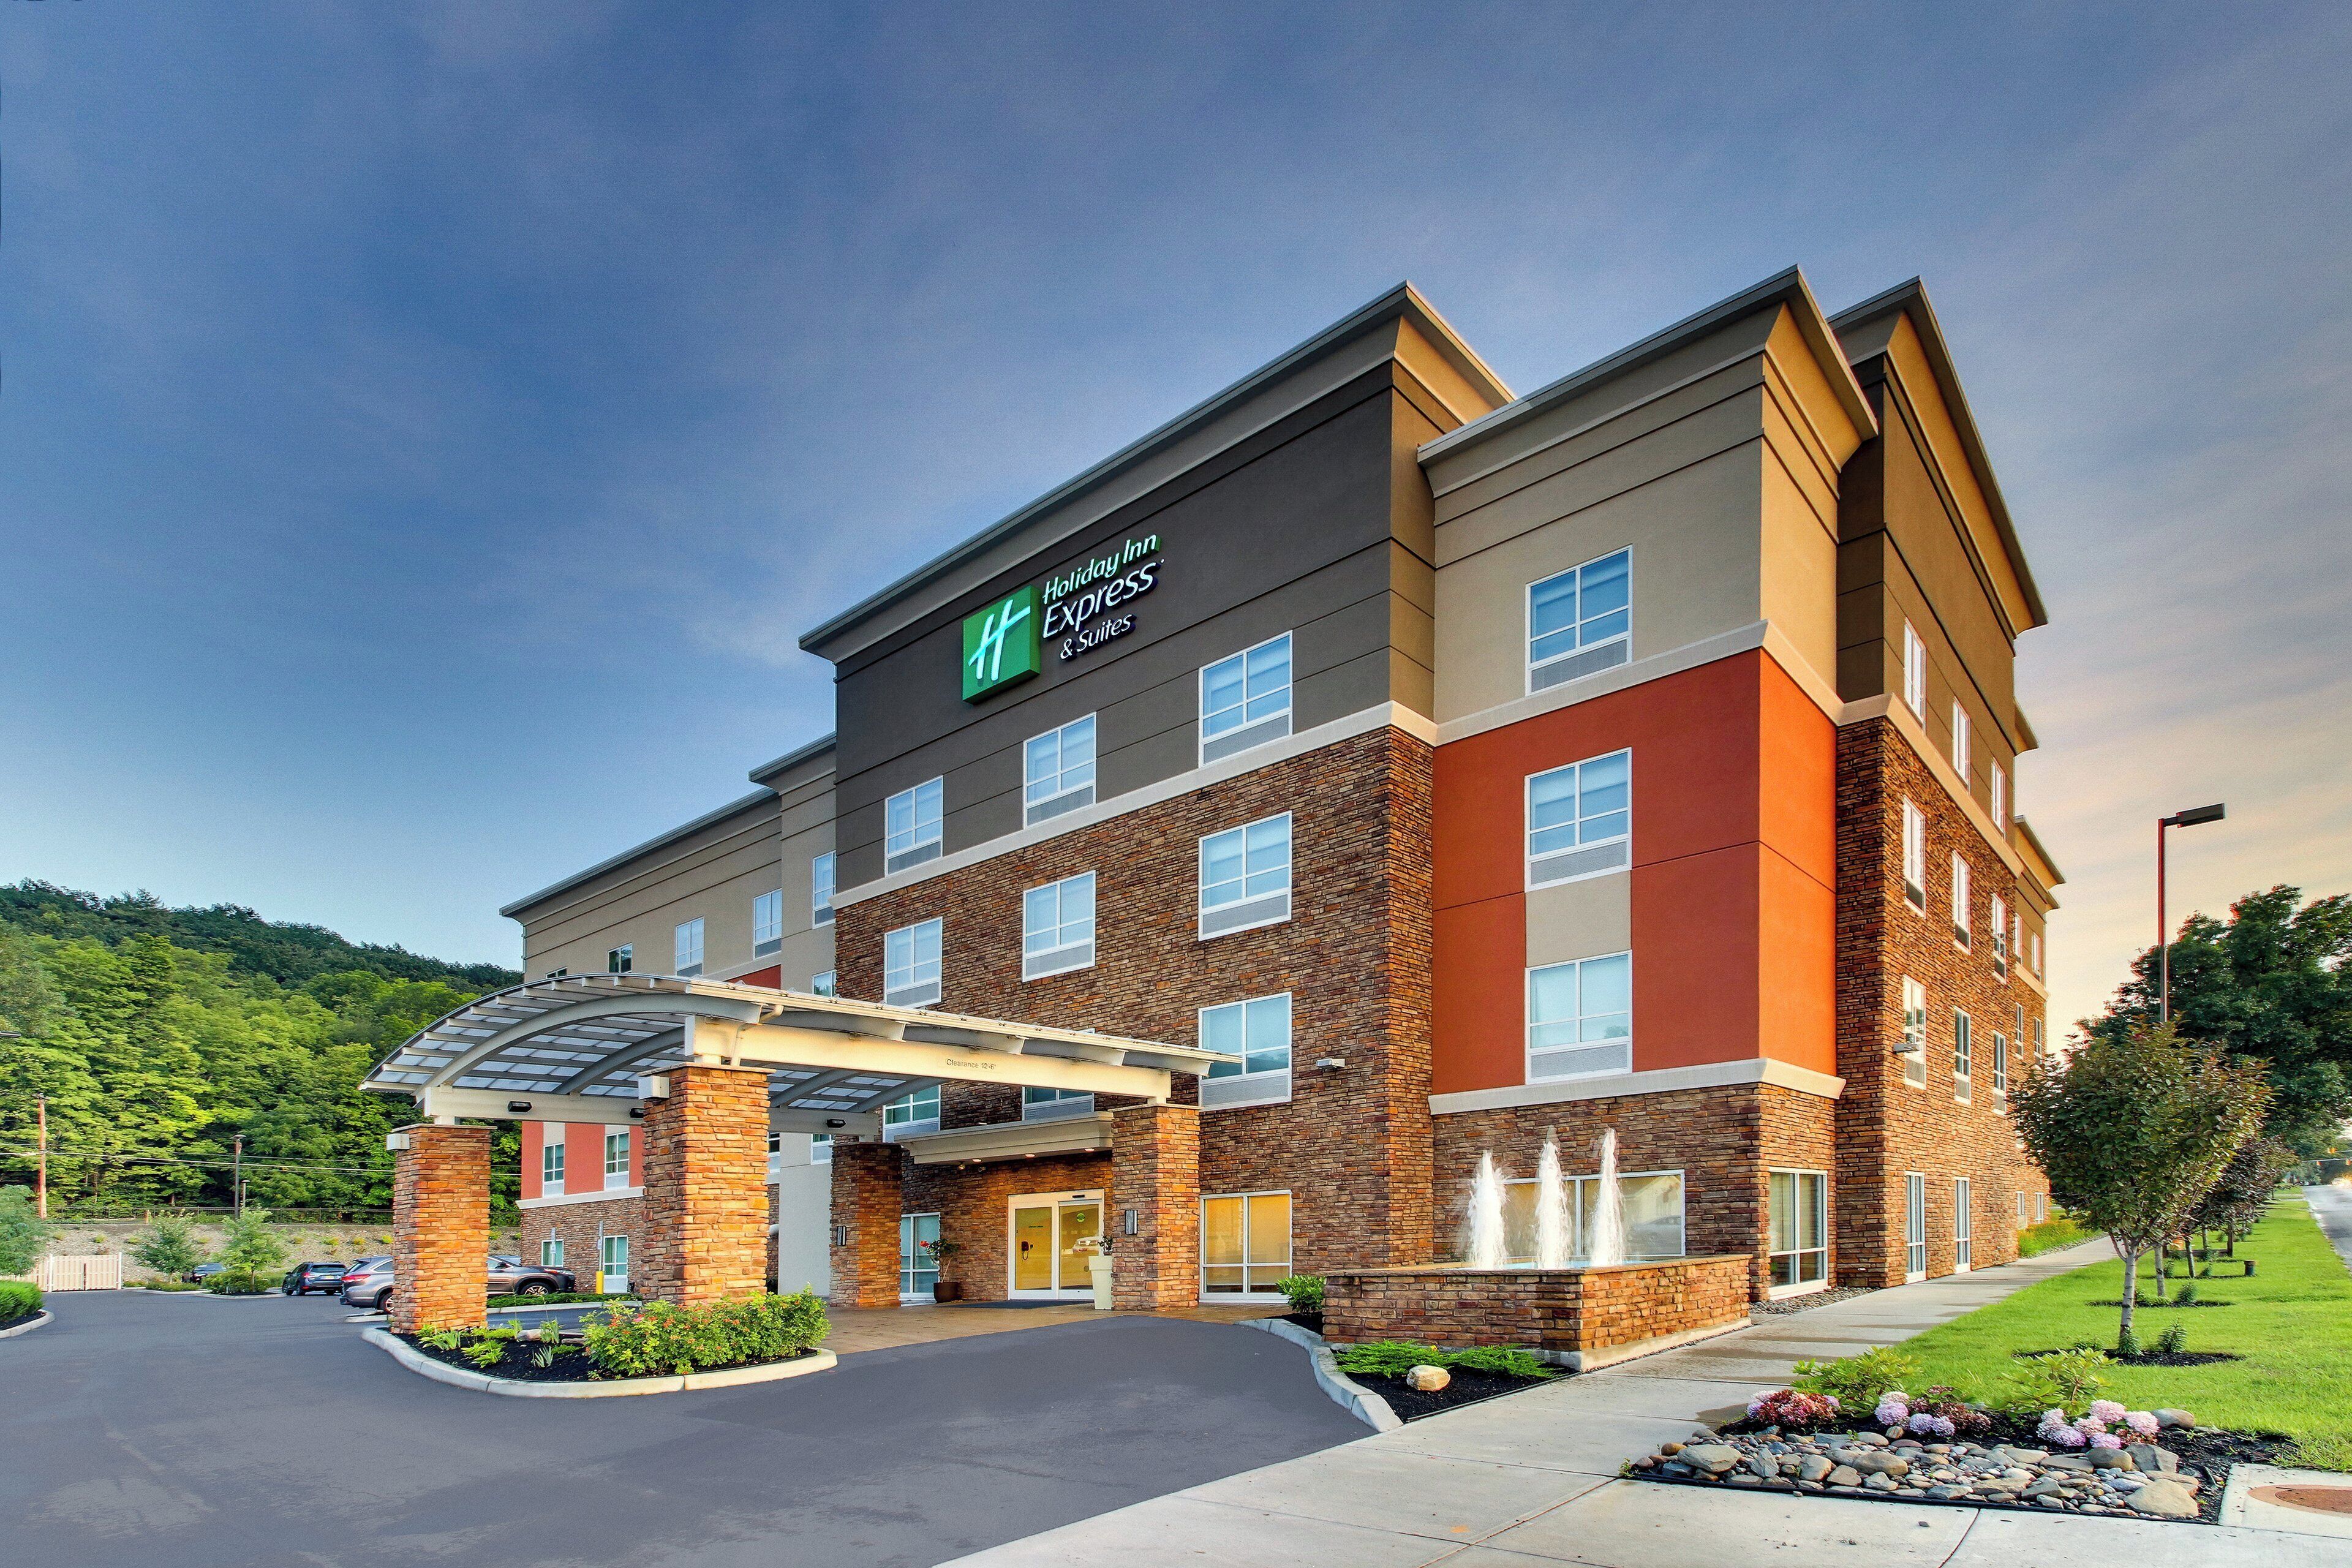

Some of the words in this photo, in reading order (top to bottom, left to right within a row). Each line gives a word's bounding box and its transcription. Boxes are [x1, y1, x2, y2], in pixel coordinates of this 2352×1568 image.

[1042, 552, 1120, 605] Holiday
[1123, 534, 1156, 564] Inn
[1042, 562, 1156, 638] Express
[1060, 638, 1073, 660] &
[1077, 614, 1133, 652] Suites
[946, 1058, 979, 1068] Clearance
